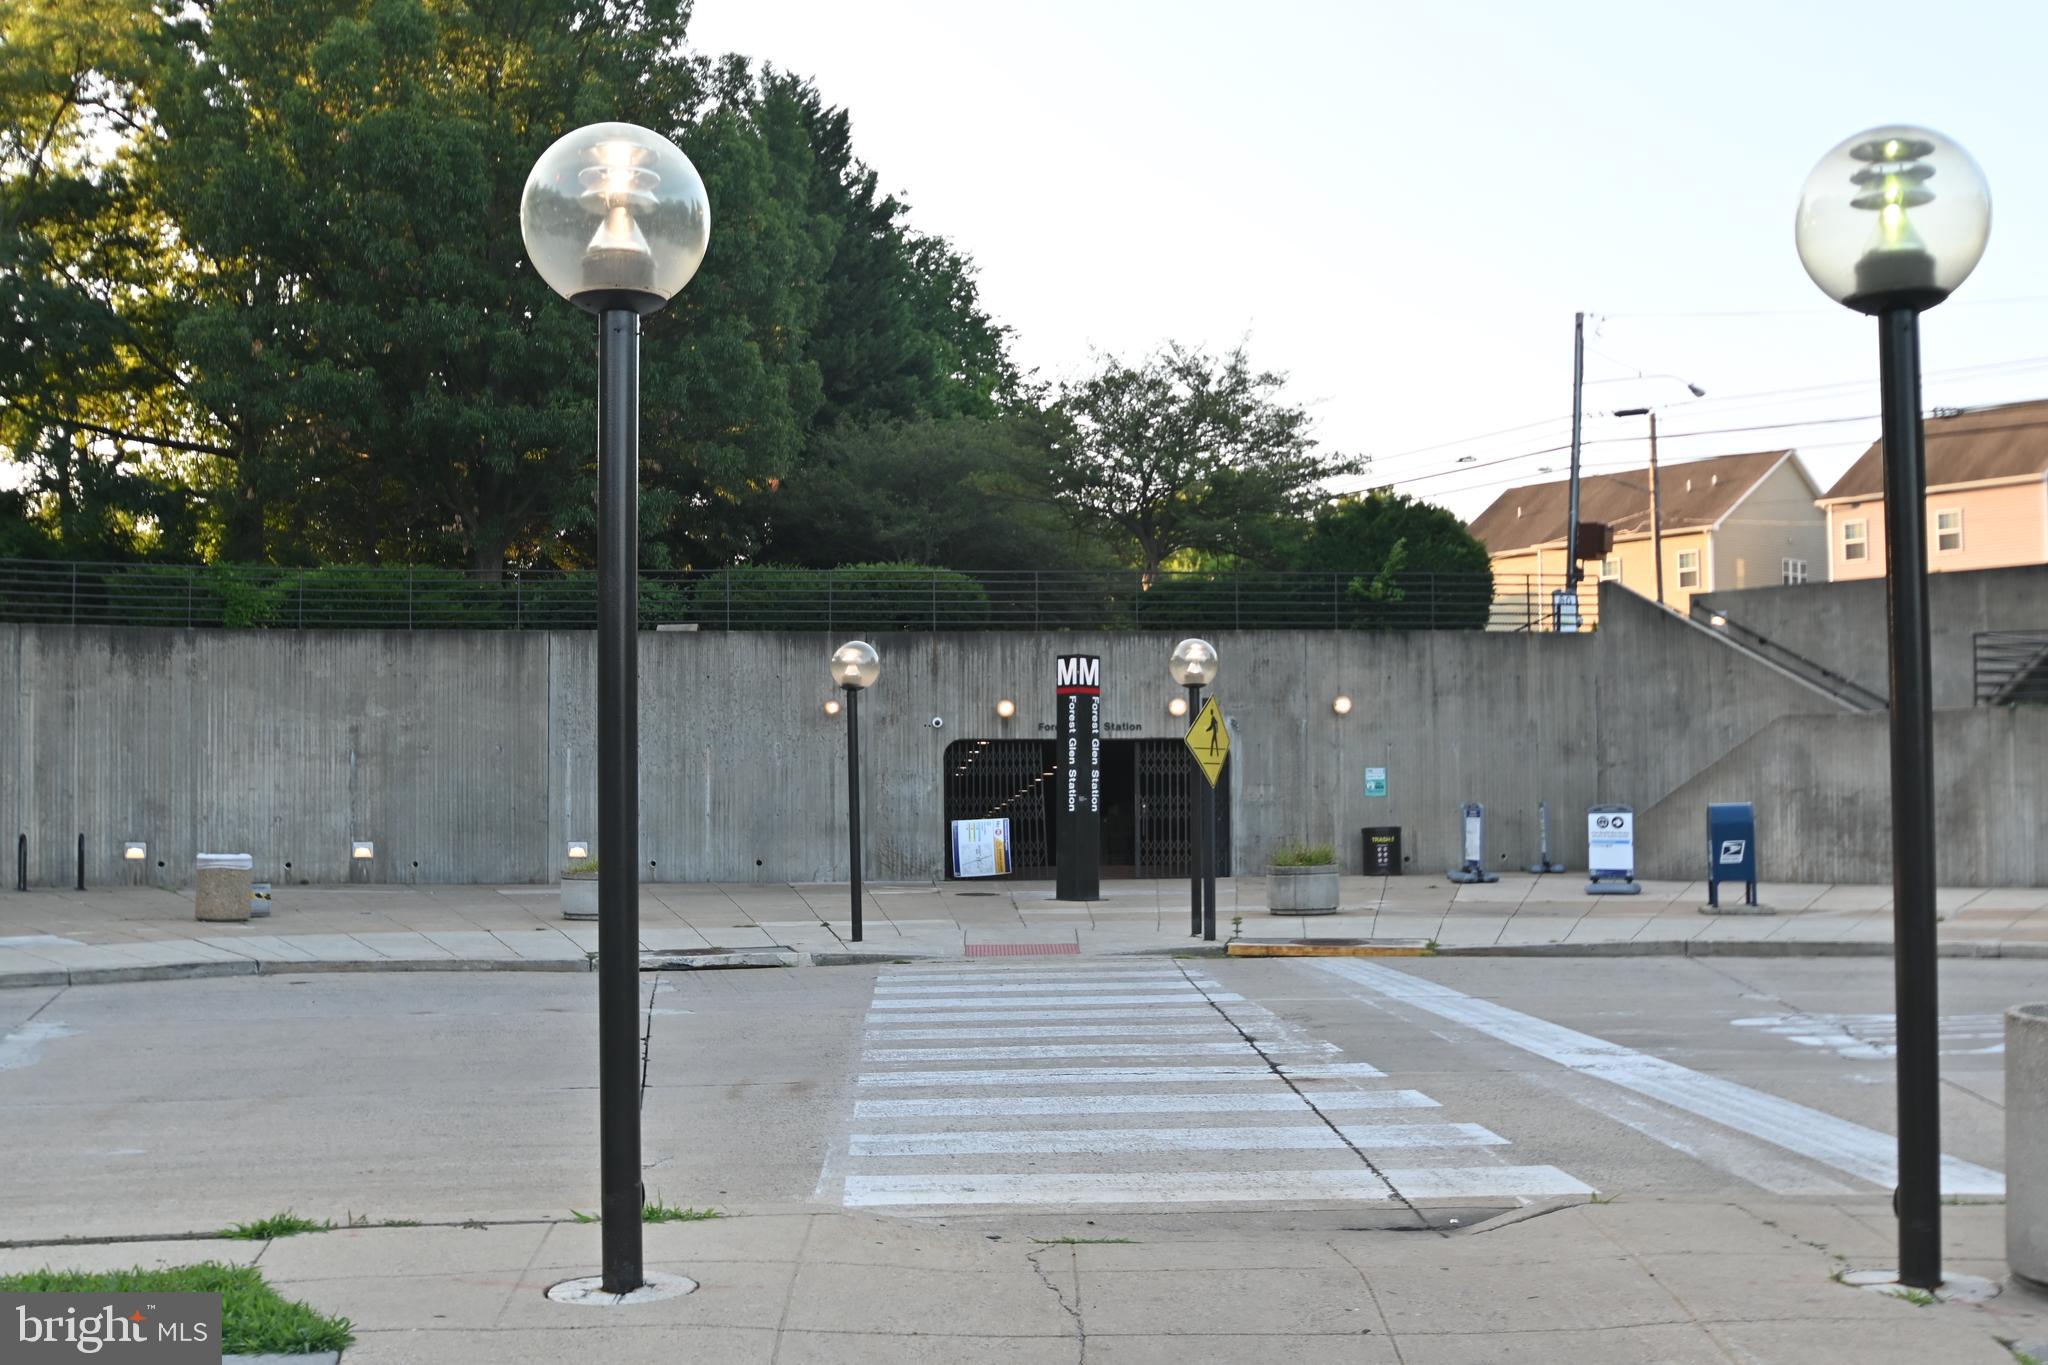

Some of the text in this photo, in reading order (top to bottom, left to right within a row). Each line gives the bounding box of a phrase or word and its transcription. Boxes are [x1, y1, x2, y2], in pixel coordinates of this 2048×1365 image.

[1068, 695, 1077, 812] Forest Glen Station
[1091, 696, 1100, 812] Forest Glen Station
[1104, 721, 1142, 731] Station
